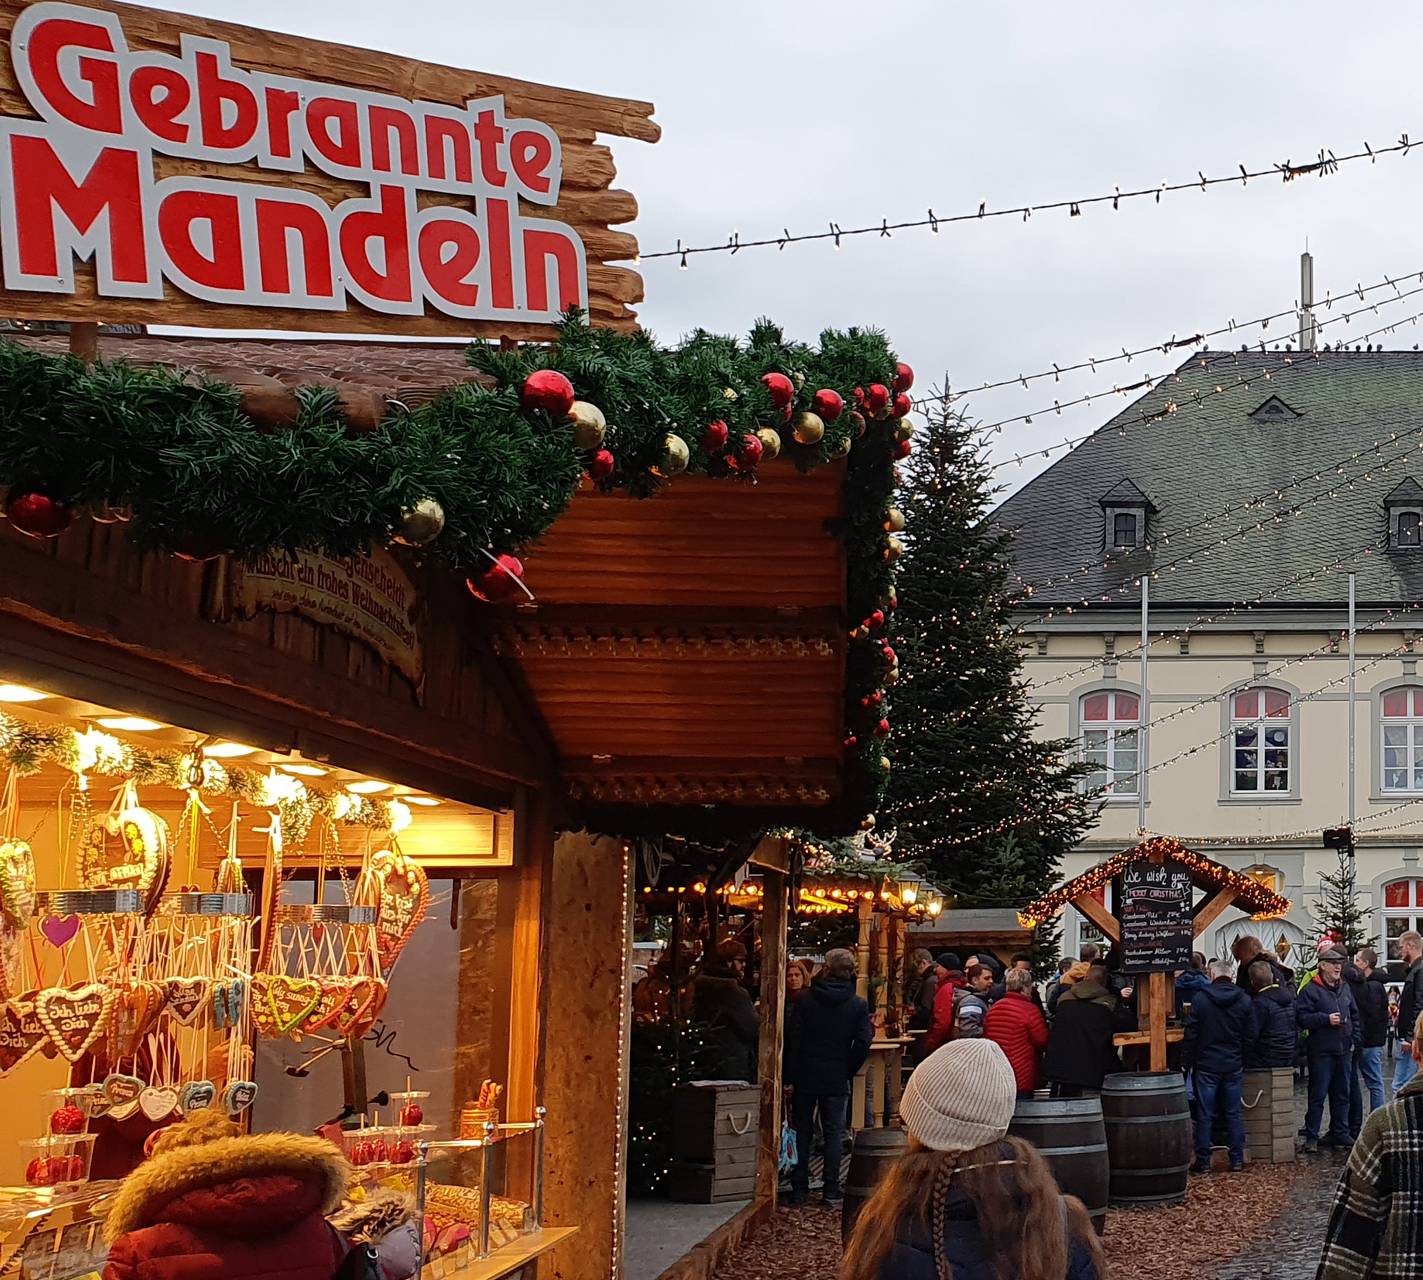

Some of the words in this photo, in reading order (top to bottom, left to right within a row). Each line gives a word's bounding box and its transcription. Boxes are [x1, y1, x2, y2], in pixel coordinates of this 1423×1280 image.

[27, 18, 554, 194] Gebrannte
[10, 133, 580, 313] Mandeln
[317, 563, 350, 601] frohes
[1124, 863, 1142, 883] We
[1146, 866, 1167, 885] wish
[1171, 872, 1189, 889] you
[1149, 889, 1182, 899] CHRISTMAS
[48, 1003, 75, 1019] Ich
[74, 999, 102, 1016] liebe
[20, 1017, 46, 1034] lieb
[61, 1017, 90, 1031] Dich
